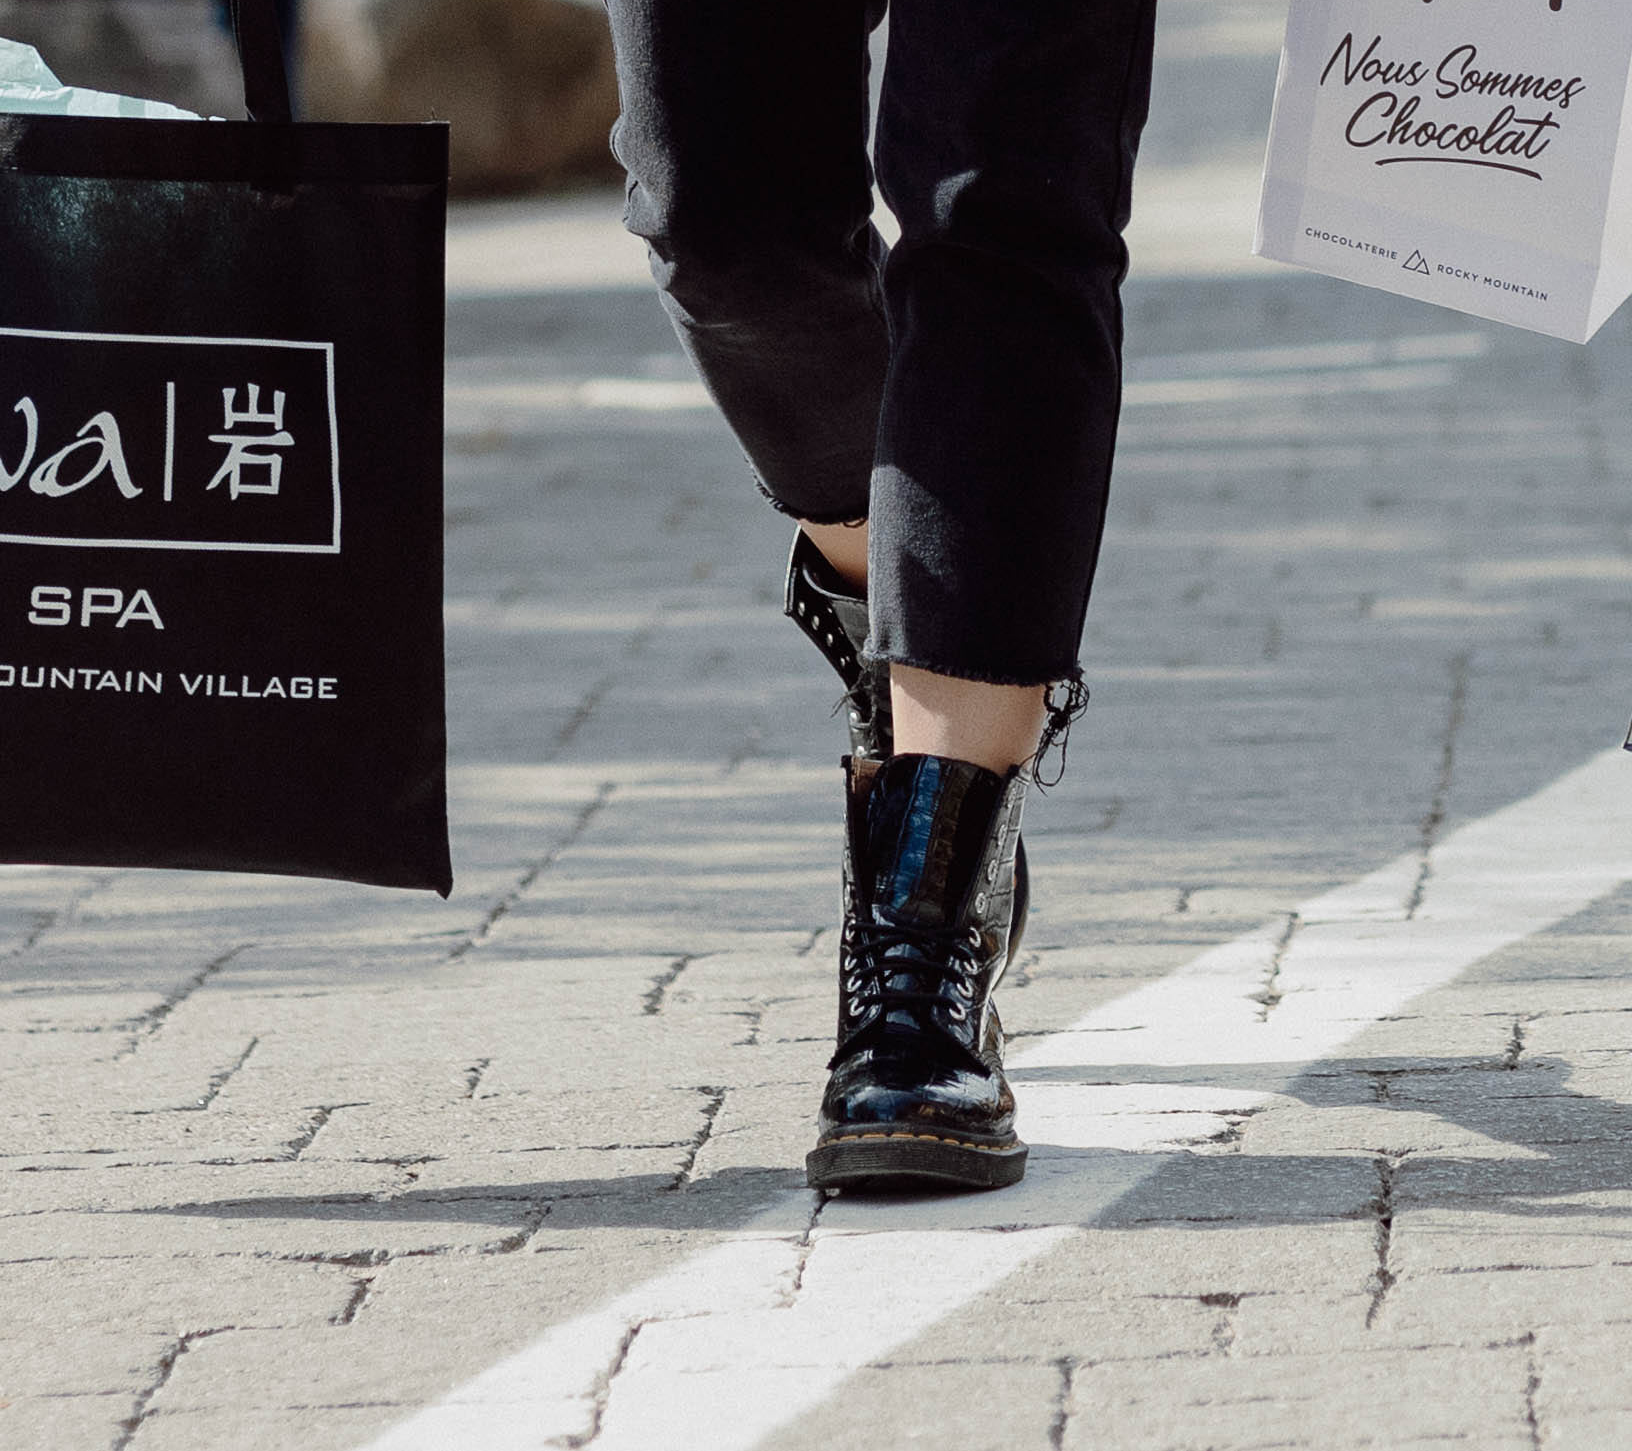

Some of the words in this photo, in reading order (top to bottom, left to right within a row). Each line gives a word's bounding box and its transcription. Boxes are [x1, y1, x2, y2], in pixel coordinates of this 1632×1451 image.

[1320, 32, 1429, 86] Nous
[1435, 44, 1586, 109] Sommes
[1345, 91, 1560, 159] Chocolat
[1305, 227, 1398, 261] CHOCOLATERIE
[1437, 264, 1479, 282] ROCKY
[1483, 276, 1549, 301] MOUNTAIN
[206, 383, 295, 500] 岩
[28, 586, 165, 629] SPA
[180, 673, 338, 699] VILLAGE
